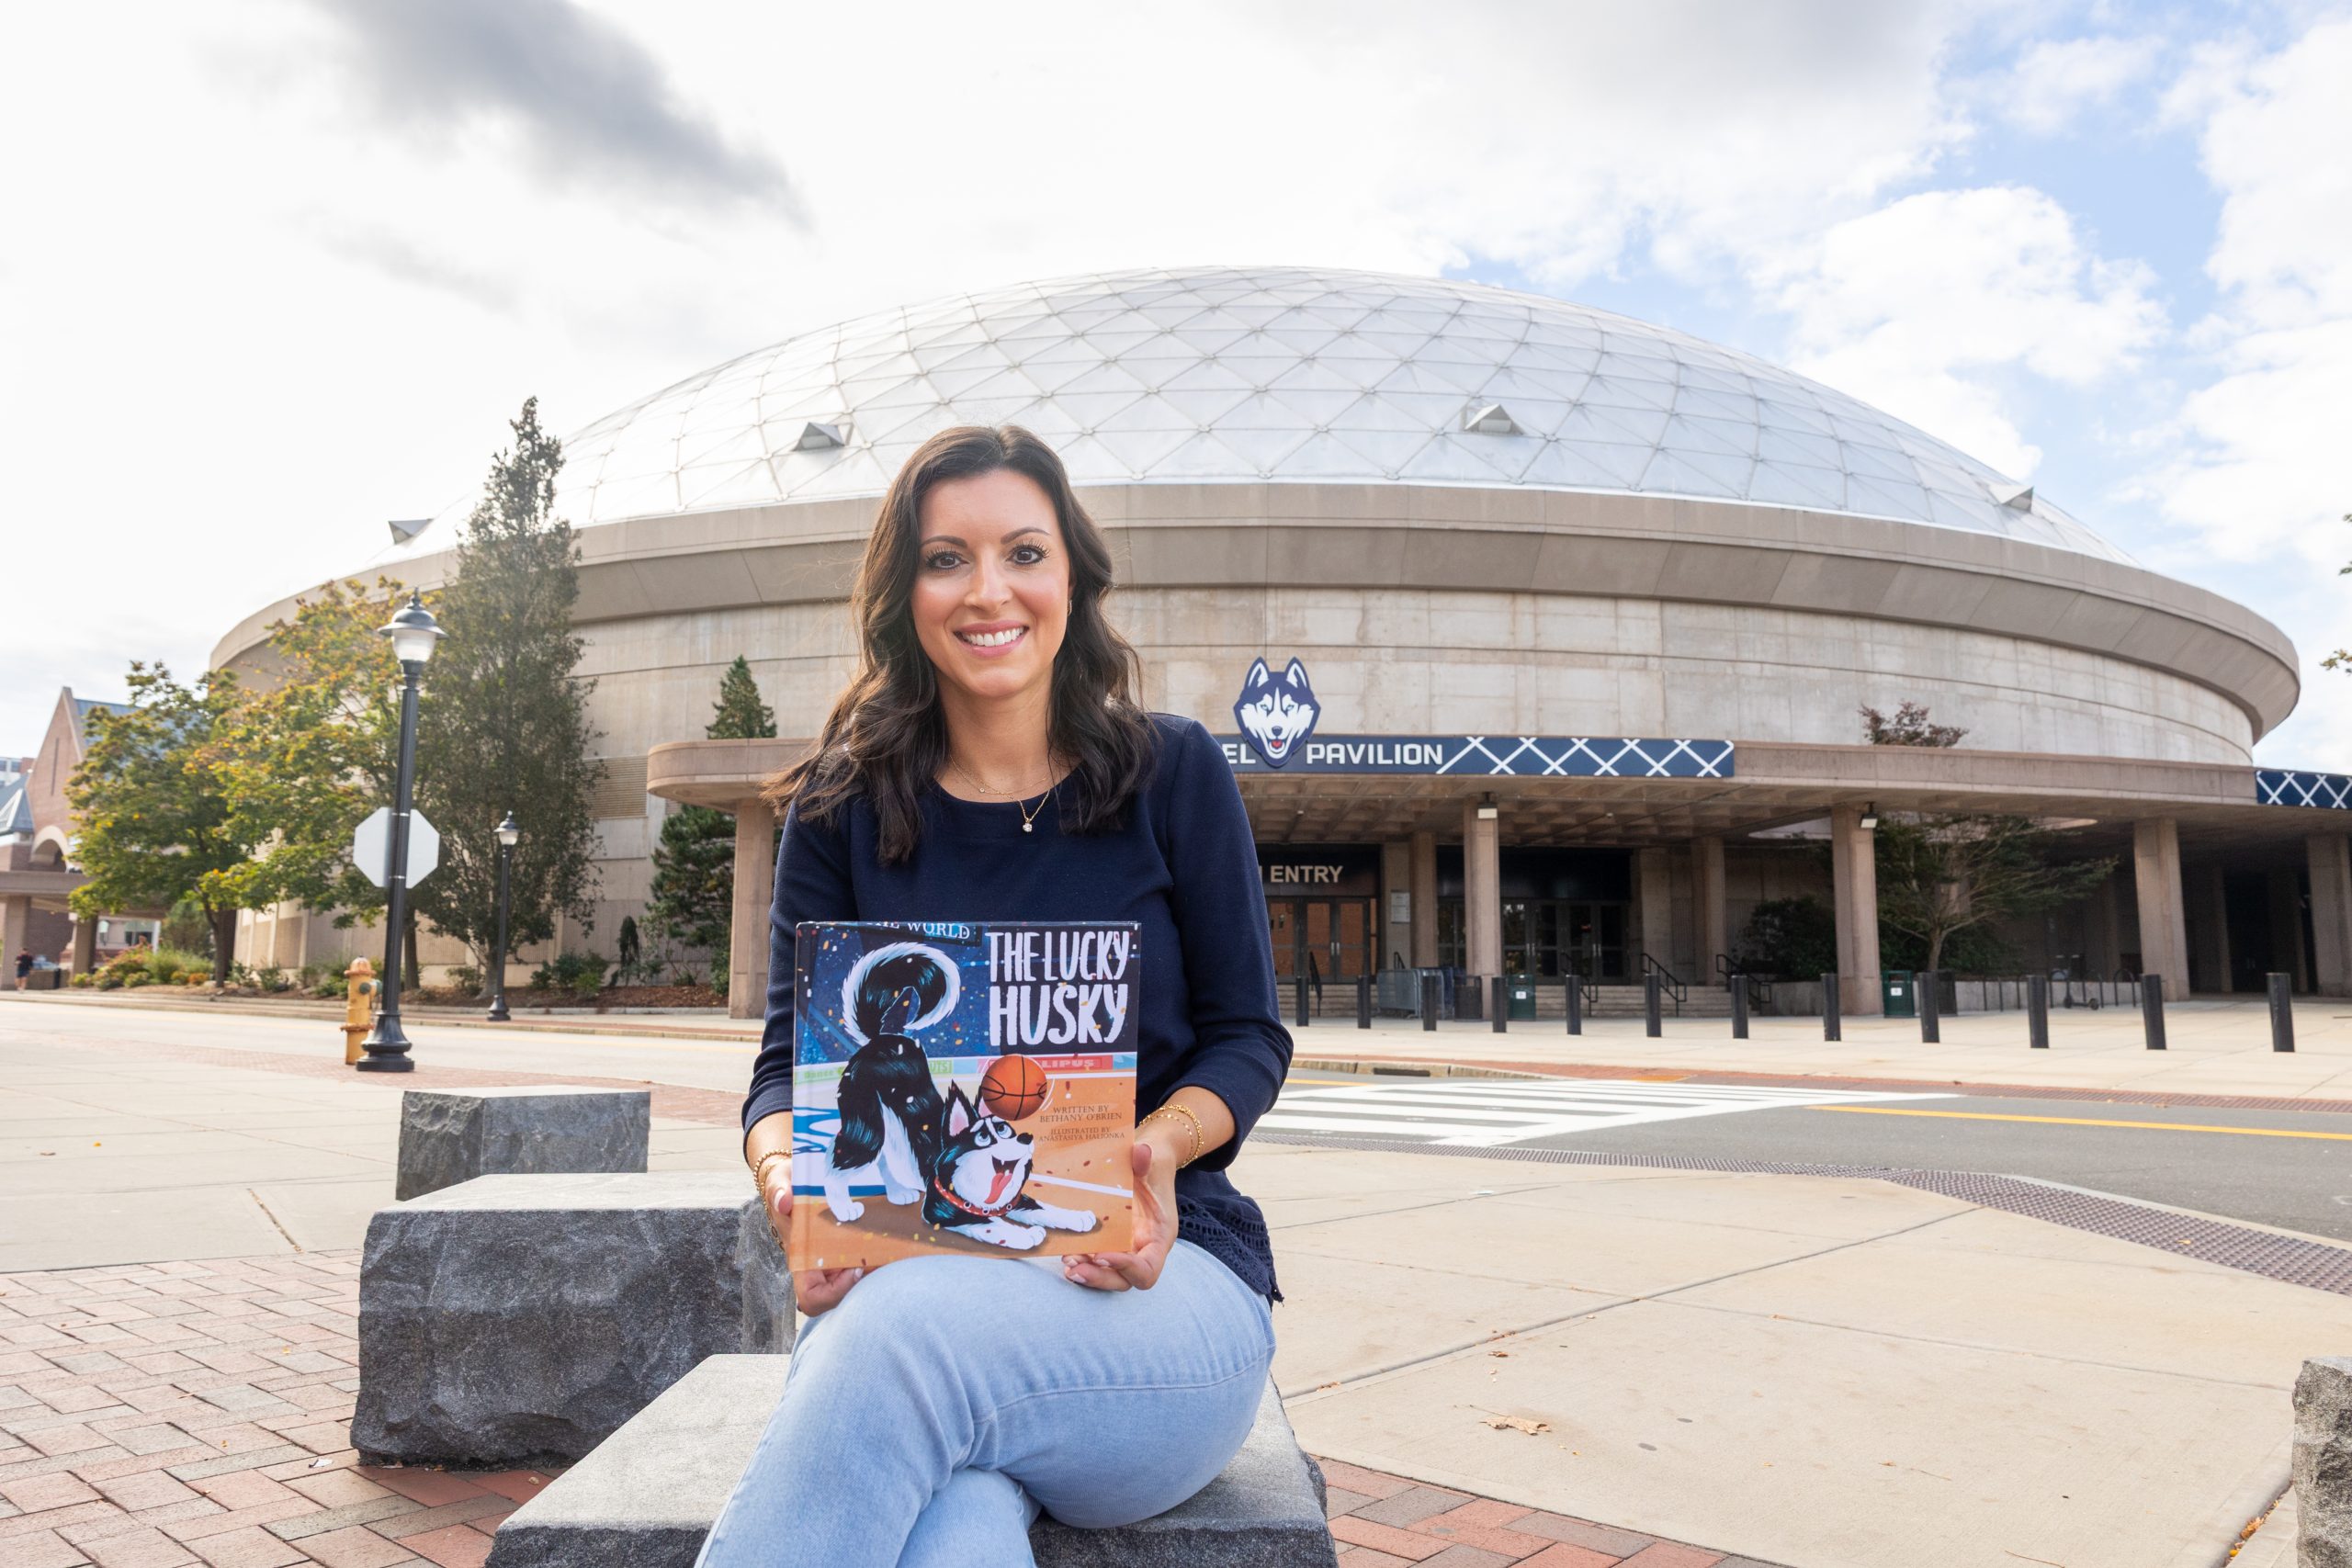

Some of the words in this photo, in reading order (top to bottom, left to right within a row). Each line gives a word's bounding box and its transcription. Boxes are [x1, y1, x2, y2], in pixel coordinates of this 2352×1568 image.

[1306, 743, 1443, 765] PAVILION
[1270, 865, 1343, 884] ENTRY
[908, 922, 970, 939] WORLD
[985, 931, 1040, 982] THE
[1044, 931, 1130, 981] LUCKY
[989, 983, 1129, 1046] HUSKY
[1040, 1113, 1084, 1123] BETHANY
[1086, 1112, 1123, 1122] O'BRIEN
[1053, 1105, 1095, 1114] WRITTEN
[1098, 1104, 1109, 1112] BY
[1050, 1127, 1099, 1135] ILLUSTRATED
